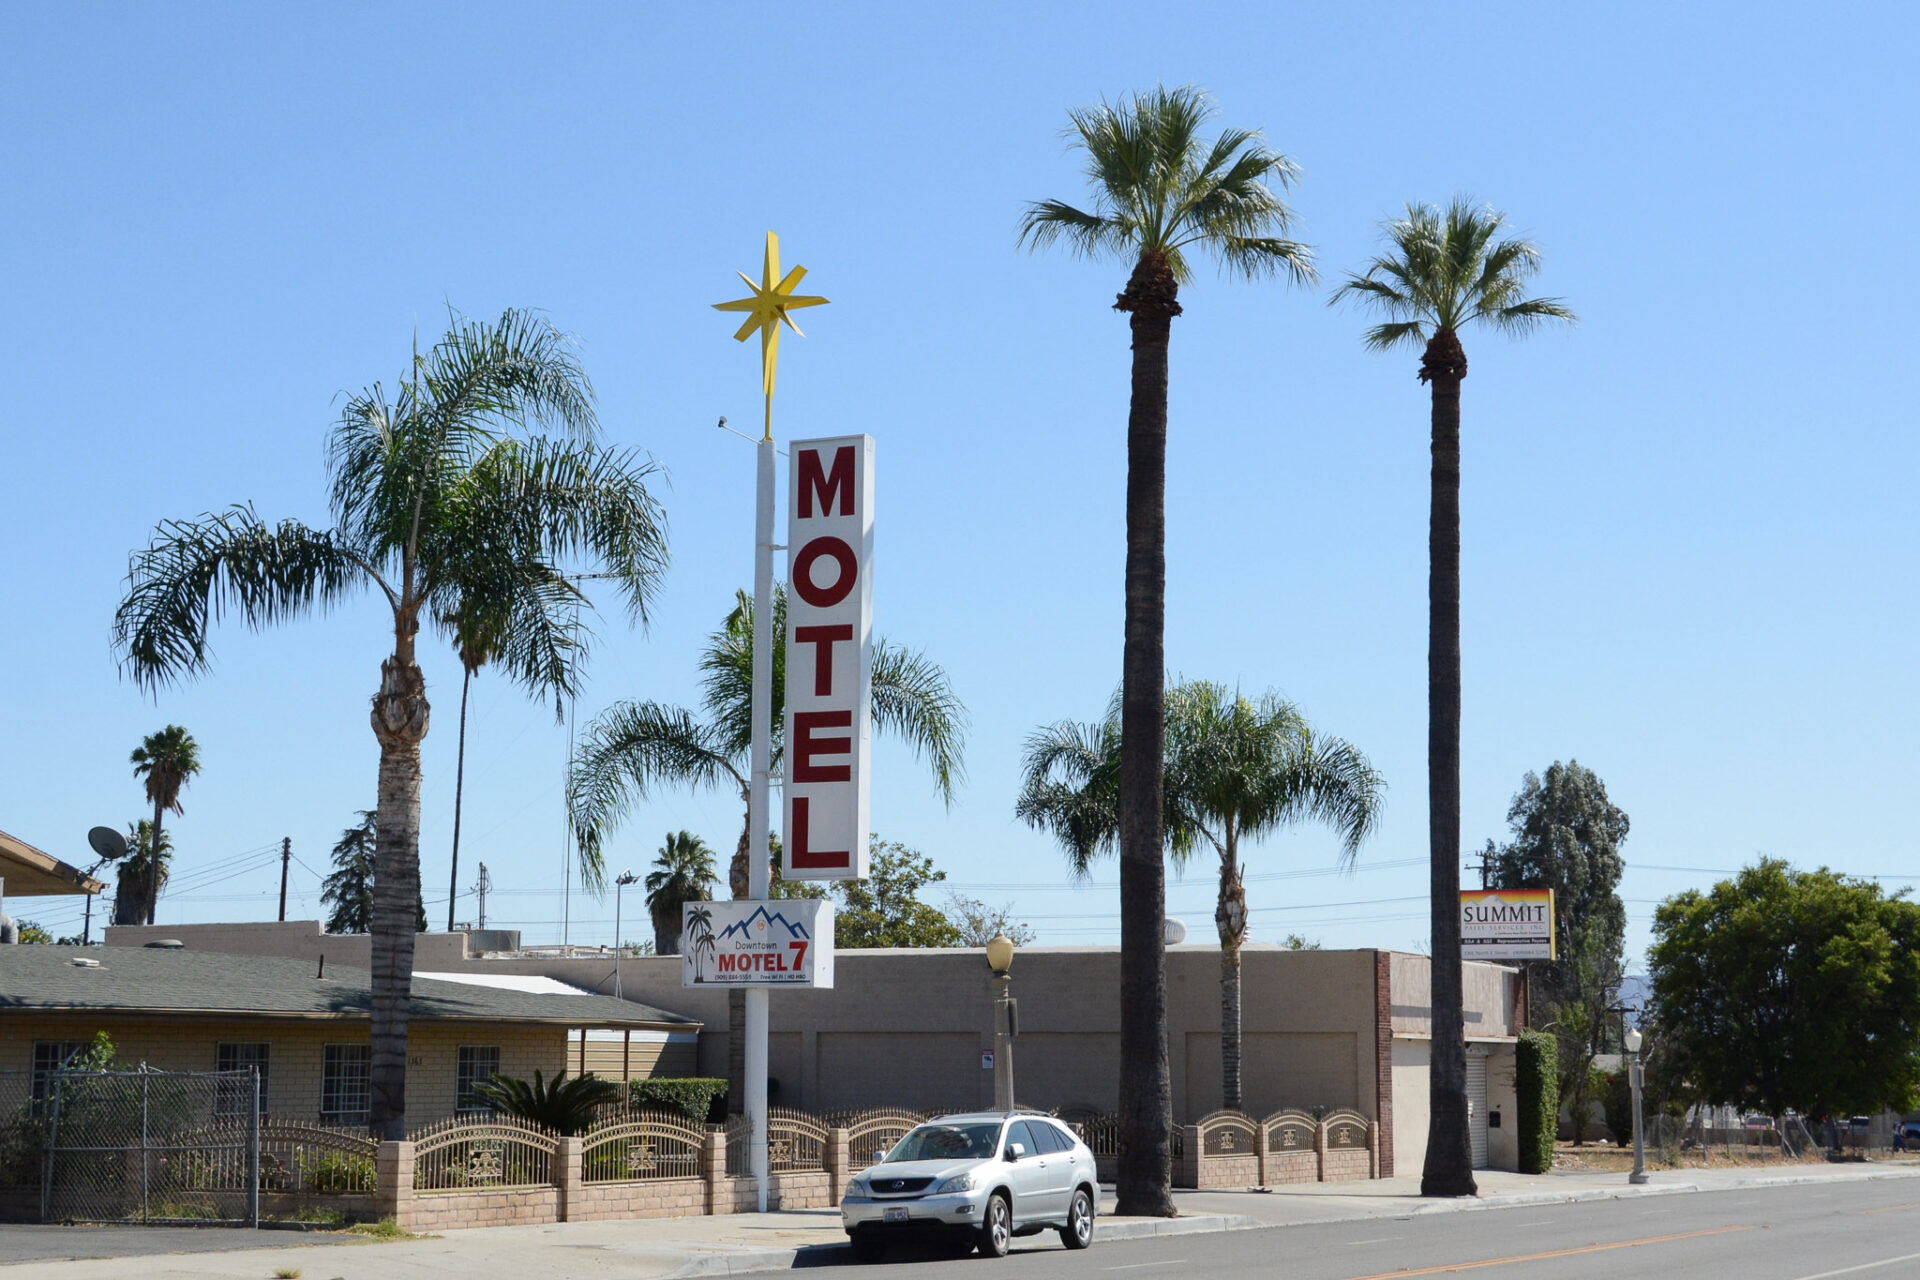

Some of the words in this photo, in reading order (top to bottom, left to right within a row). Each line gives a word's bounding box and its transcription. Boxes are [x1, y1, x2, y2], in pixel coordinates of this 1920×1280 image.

[791, 446, 858, 869] MOTEL
[1464, 905, 1545, 922] SUMMIT
[718, 953, 788, 972] MOTEL
[788, 941, 809, 971] 7
[735, 941, 777, 950] Downtown
